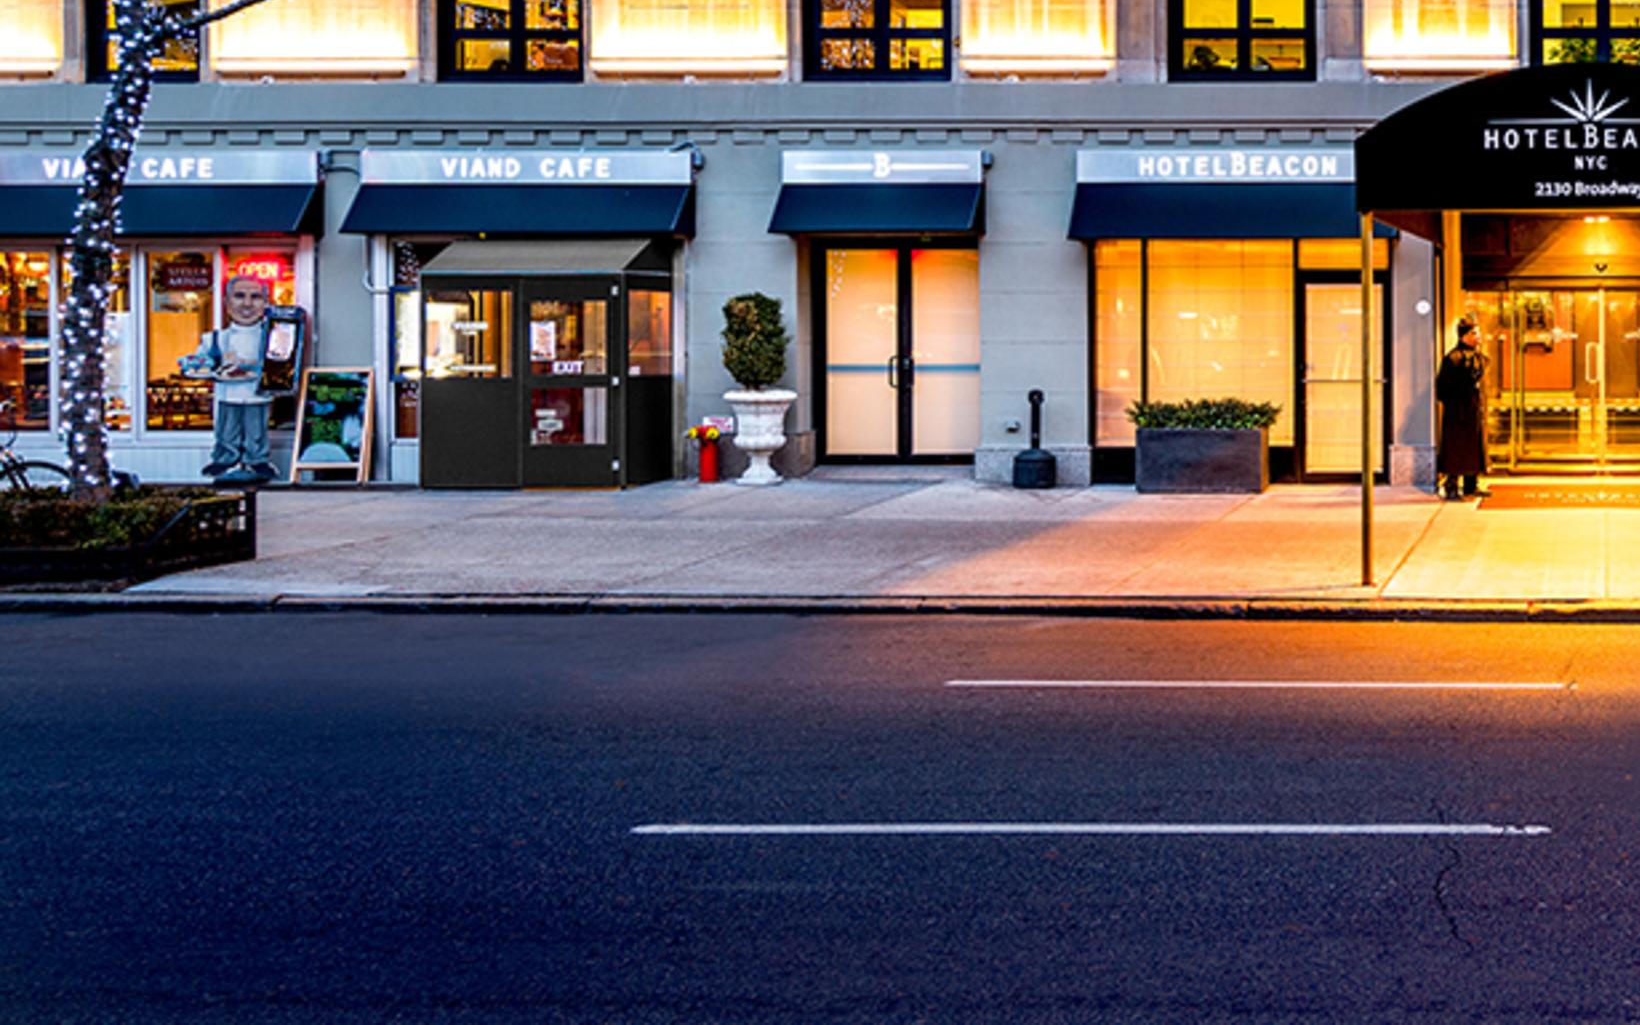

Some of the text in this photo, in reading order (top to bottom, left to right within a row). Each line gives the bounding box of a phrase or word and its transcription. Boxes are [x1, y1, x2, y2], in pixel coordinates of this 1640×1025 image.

[141, 158, 214, 178] CAFE
[441, 157, 611, 178] VIAND CAFE
[873, 152, 890, 178] B
[1574, 155, 1607, 170] NYC
[1534, 181, 1572, 197] 2130
[238, 262, 279, 279] OPEN
[552, 360, 584, 374] EXIT
